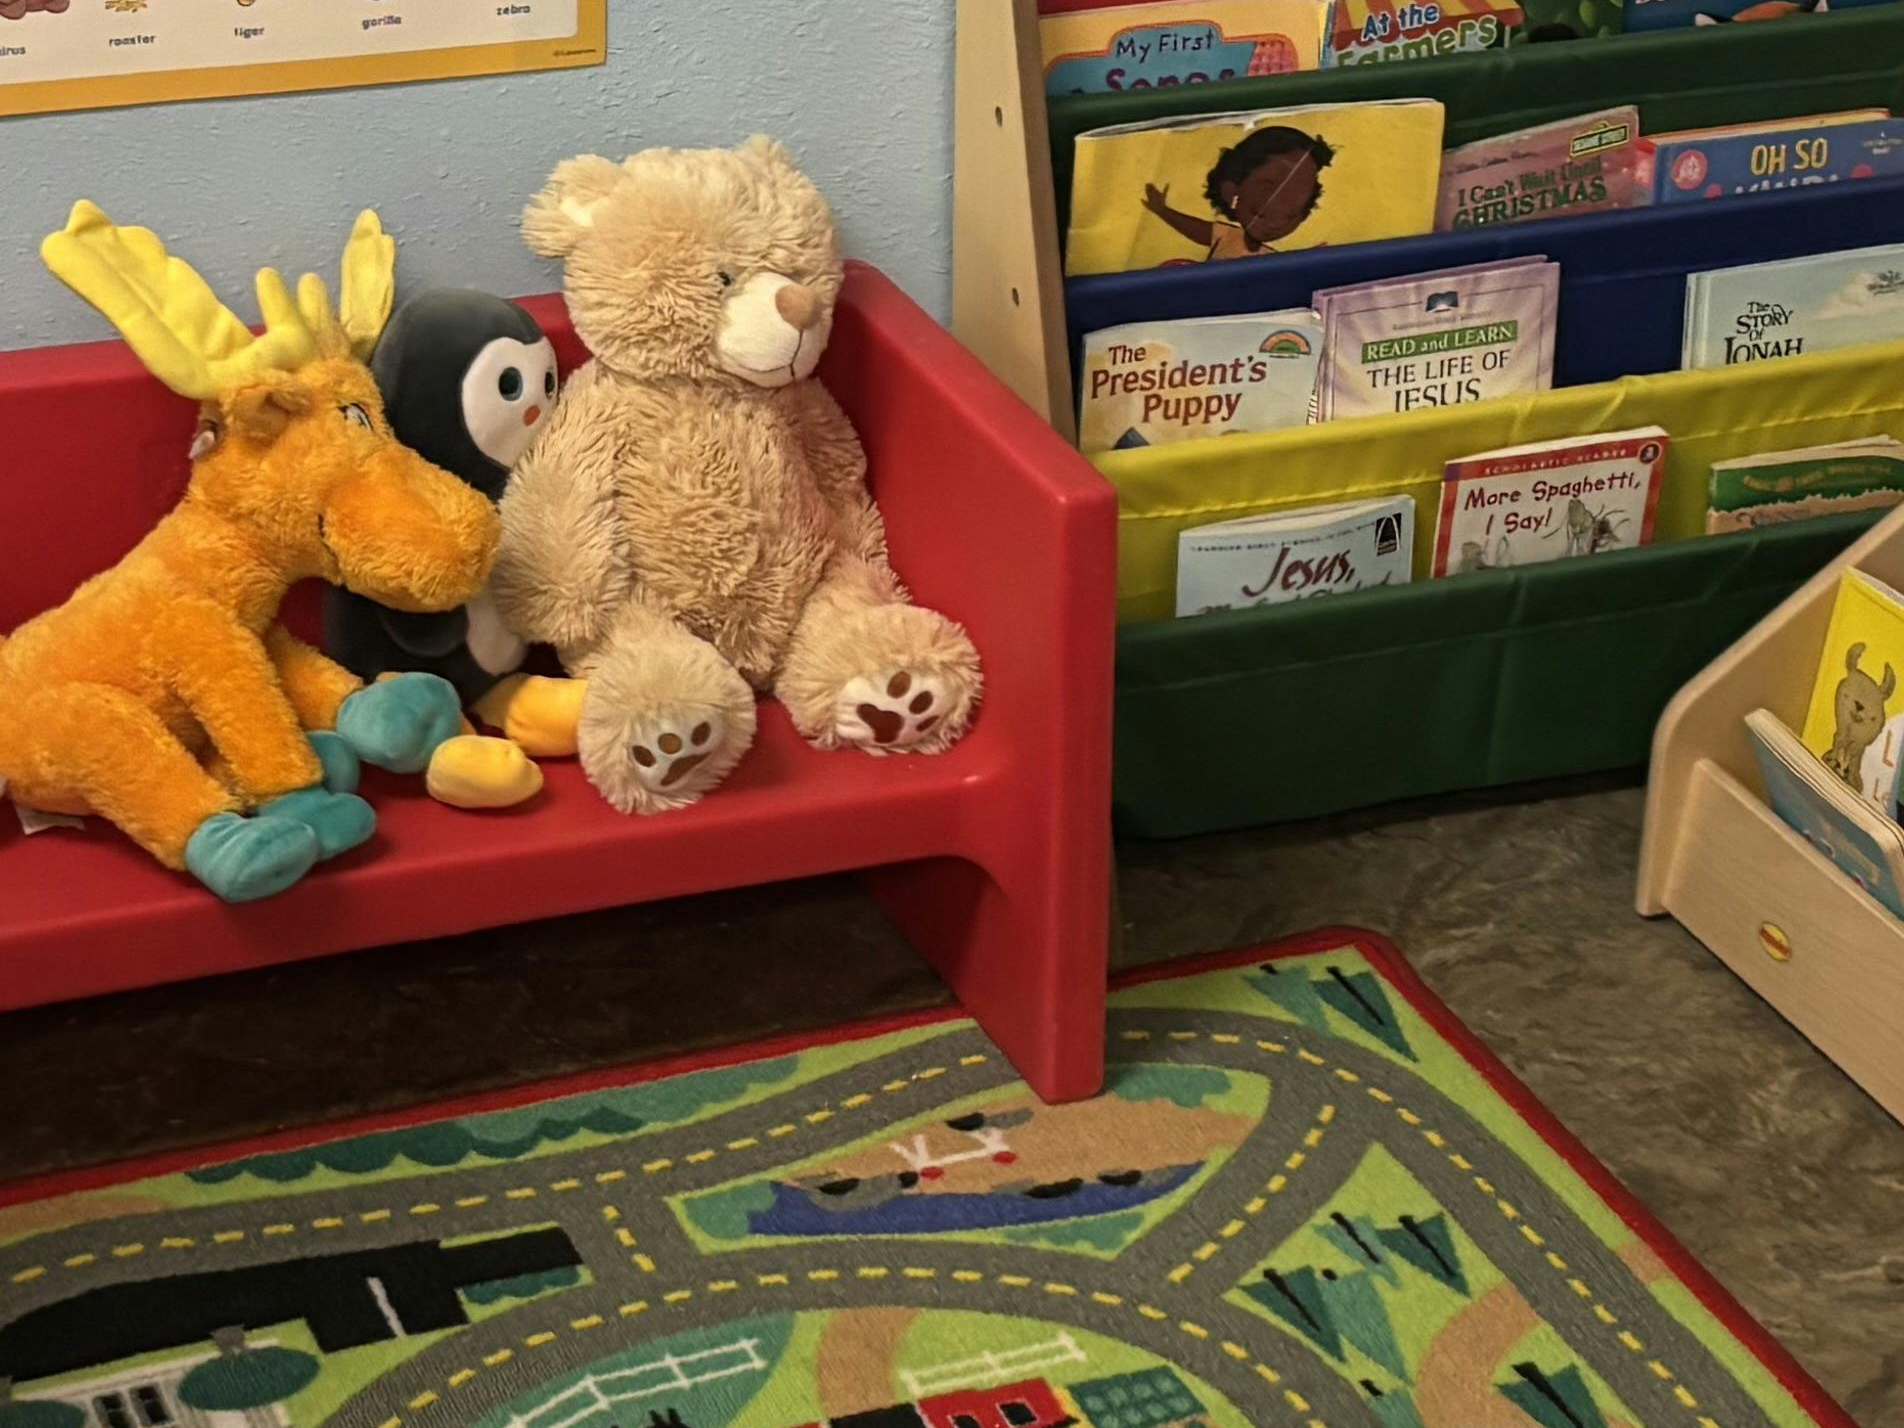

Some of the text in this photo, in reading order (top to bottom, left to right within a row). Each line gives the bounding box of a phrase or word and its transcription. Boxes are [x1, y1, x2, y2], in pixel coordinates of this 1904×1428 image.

[1363, 14, 1391, 42] At
[1397, 2, 1440, 29] the
[109, 34, 156, 47] rooster
[1116, 28, 1215, 65] My First
[1751, 144, 1786, 176] OH
[1793, 137, 1828, 170] SO
[1736, 304, 1794, 336] STORY
[1108, 344, 1146, 366] The
[1366, 325, 1514, 360] READ and LEARN
[1724, 336, 1804, 365] JONAH
[1091, 355, 1267, 399] President's
[1366, 349, 1511, 389] THE LIFE OF
[1142, 391, 1242, 425] Puppy
[1395, 377, 1481, 413] JESUS
[1463, 471, 1642, 511] More Spaghetti,
[1485, 507, 1554, 536] I Say!
[1242, 545, 1361, 598] Jesus,
